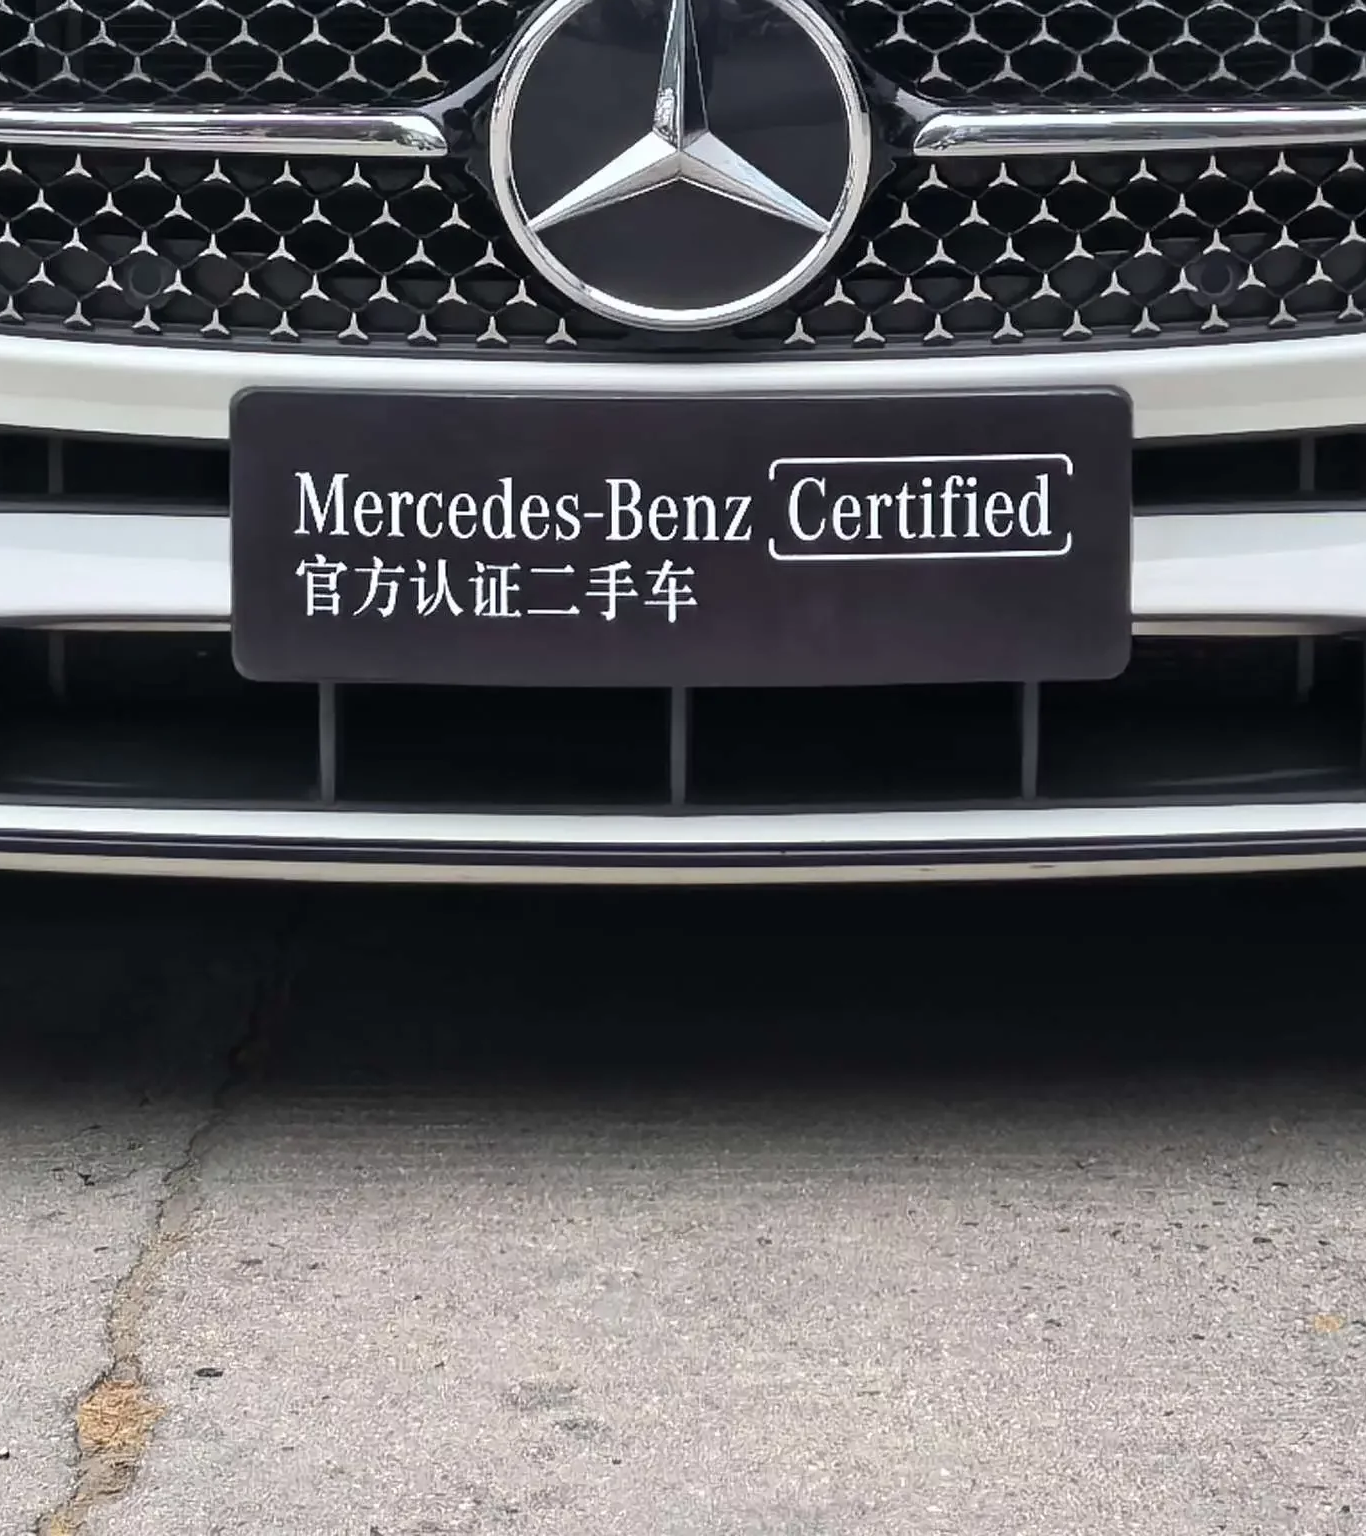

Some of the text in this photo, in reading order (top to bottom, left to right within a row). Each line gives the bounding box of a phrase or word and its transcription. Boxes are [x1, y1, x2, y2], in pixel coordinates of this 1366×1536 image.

[295, 472, 1052, 541] Mercedes-Benz Certified
[296, 554, 698, 624] 官方认证二手车
